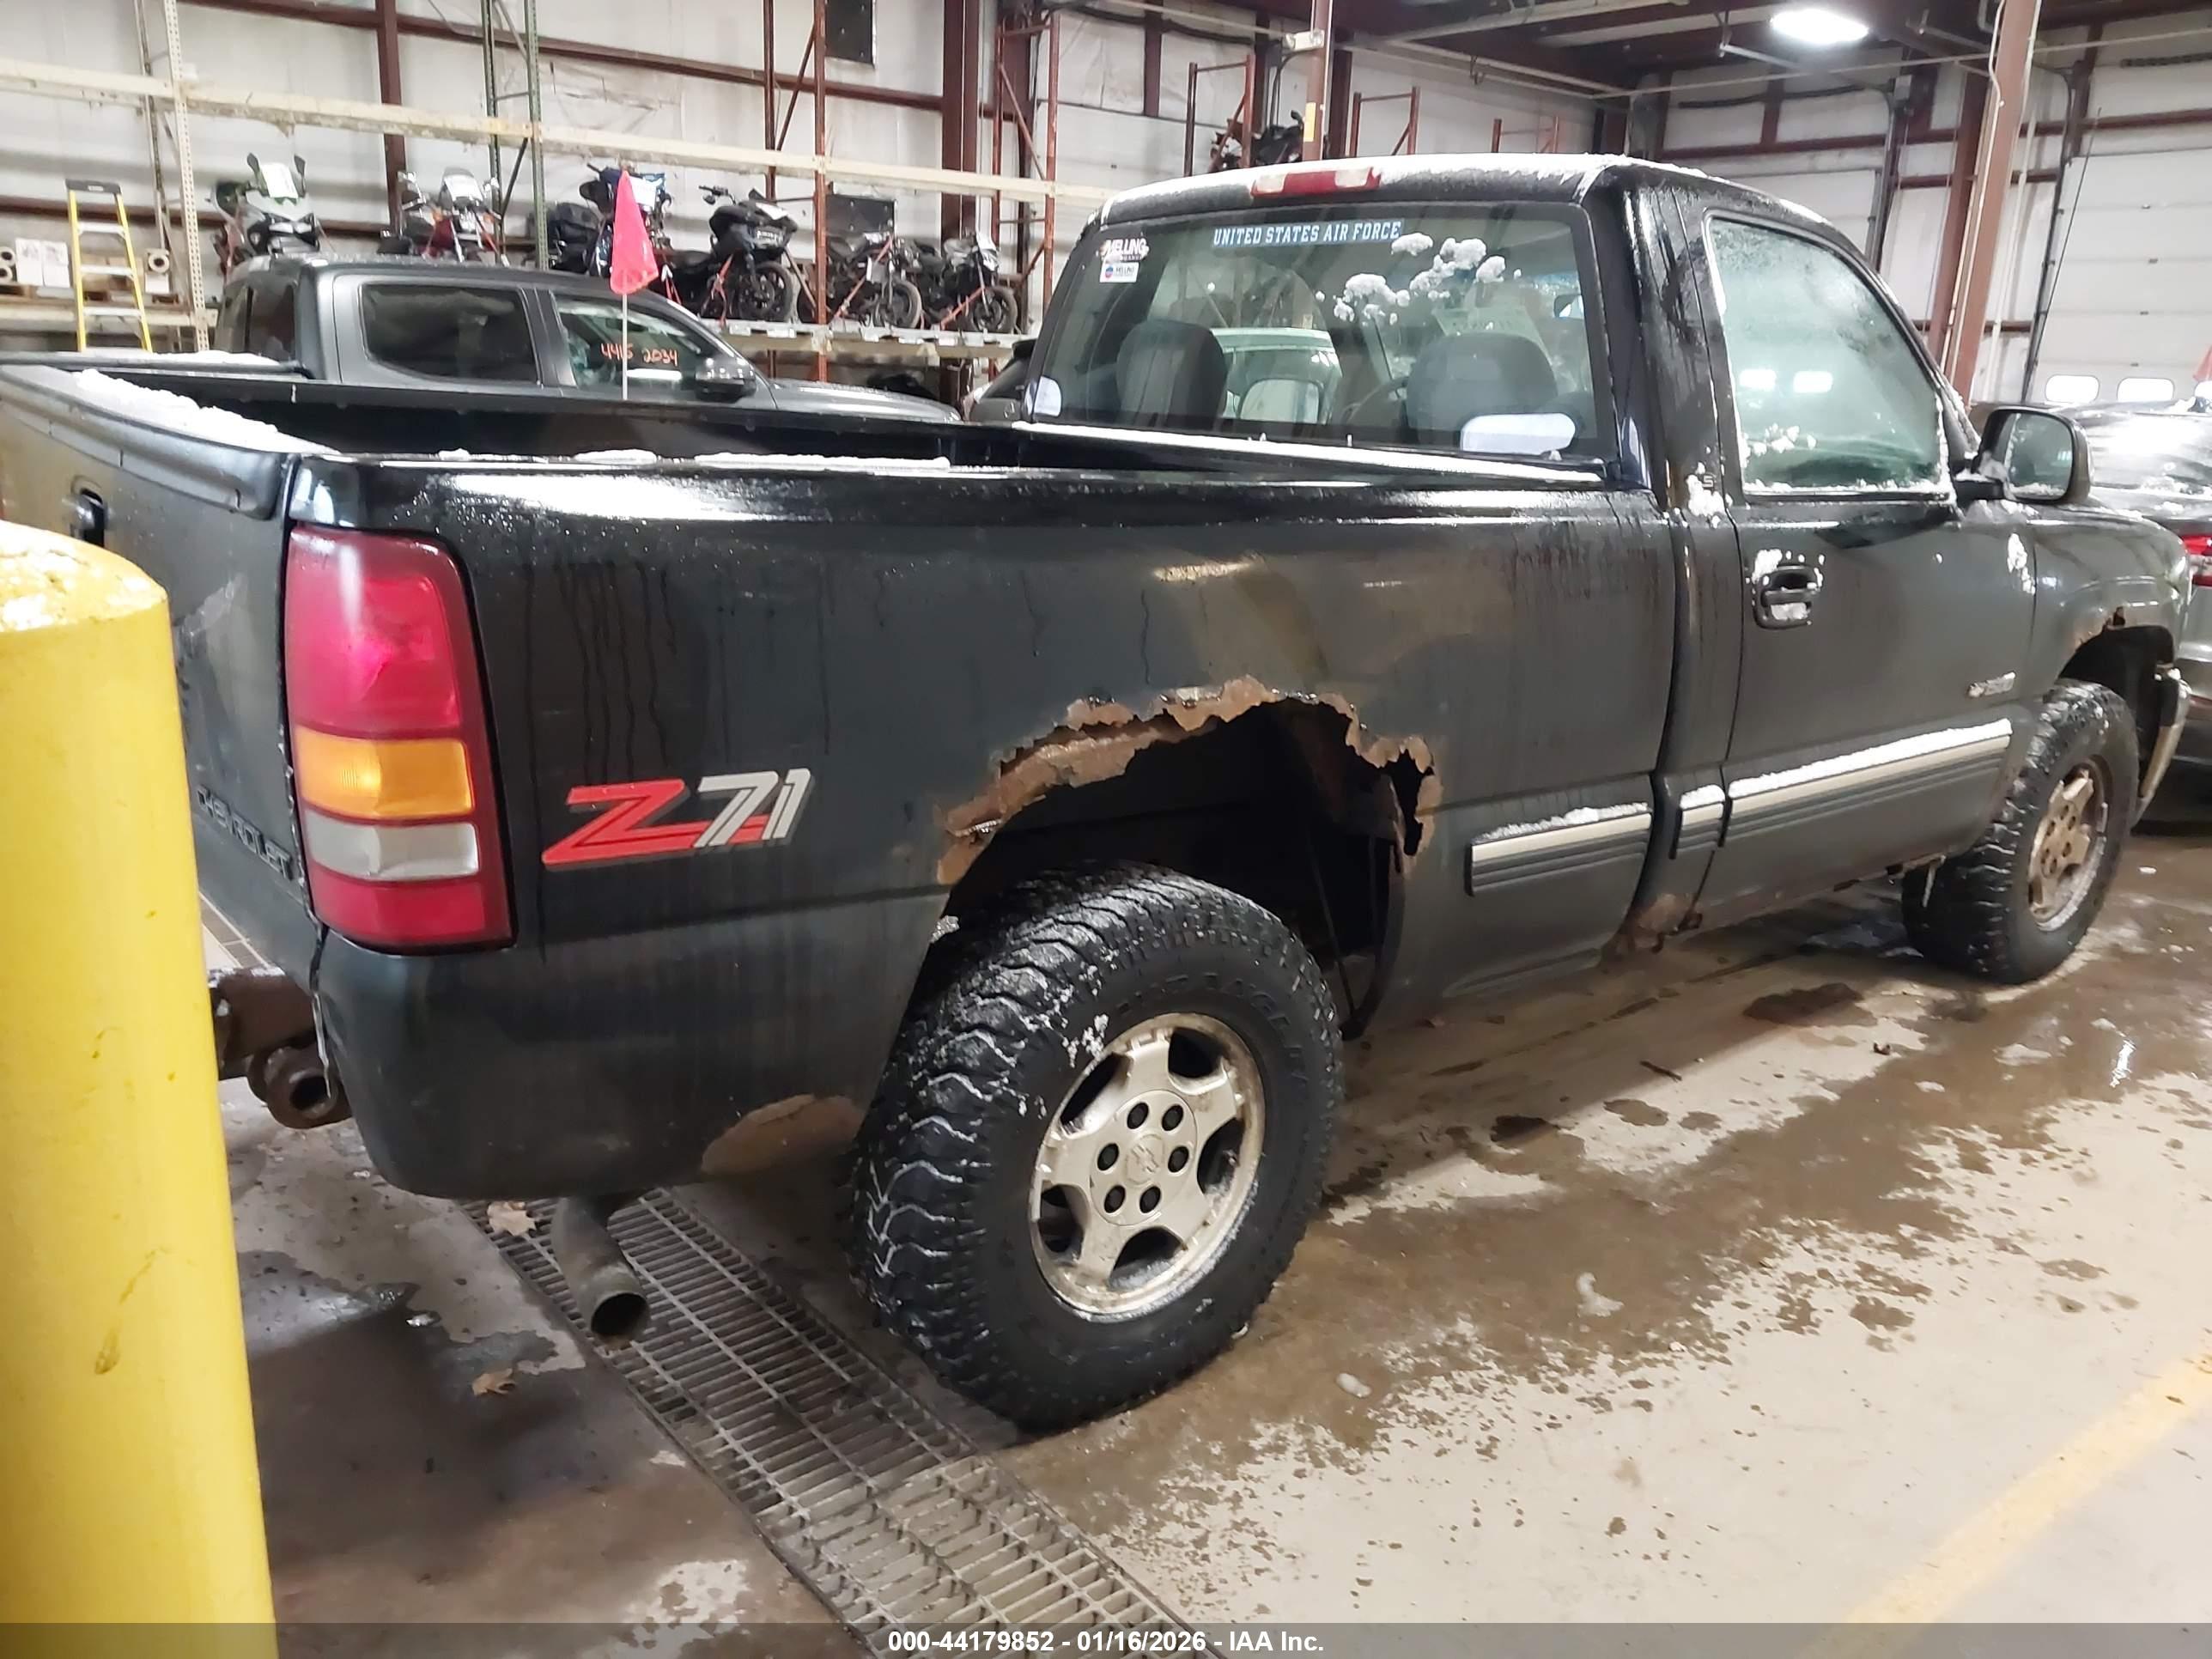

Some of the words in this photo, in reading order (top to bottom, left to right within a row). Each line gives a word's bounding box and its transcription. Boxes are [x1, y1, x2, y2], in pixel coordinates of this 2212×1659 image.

[1213, 228, 1261, 246] UNITED
[1265, 225, 1320, 244] STATES
[1323, 222, 1348, 241] AIR
[1352, 221, 1402, 240] FORCE
[641, 347, 678, 367] 2034
[542, 768, 811, 866] Z71
